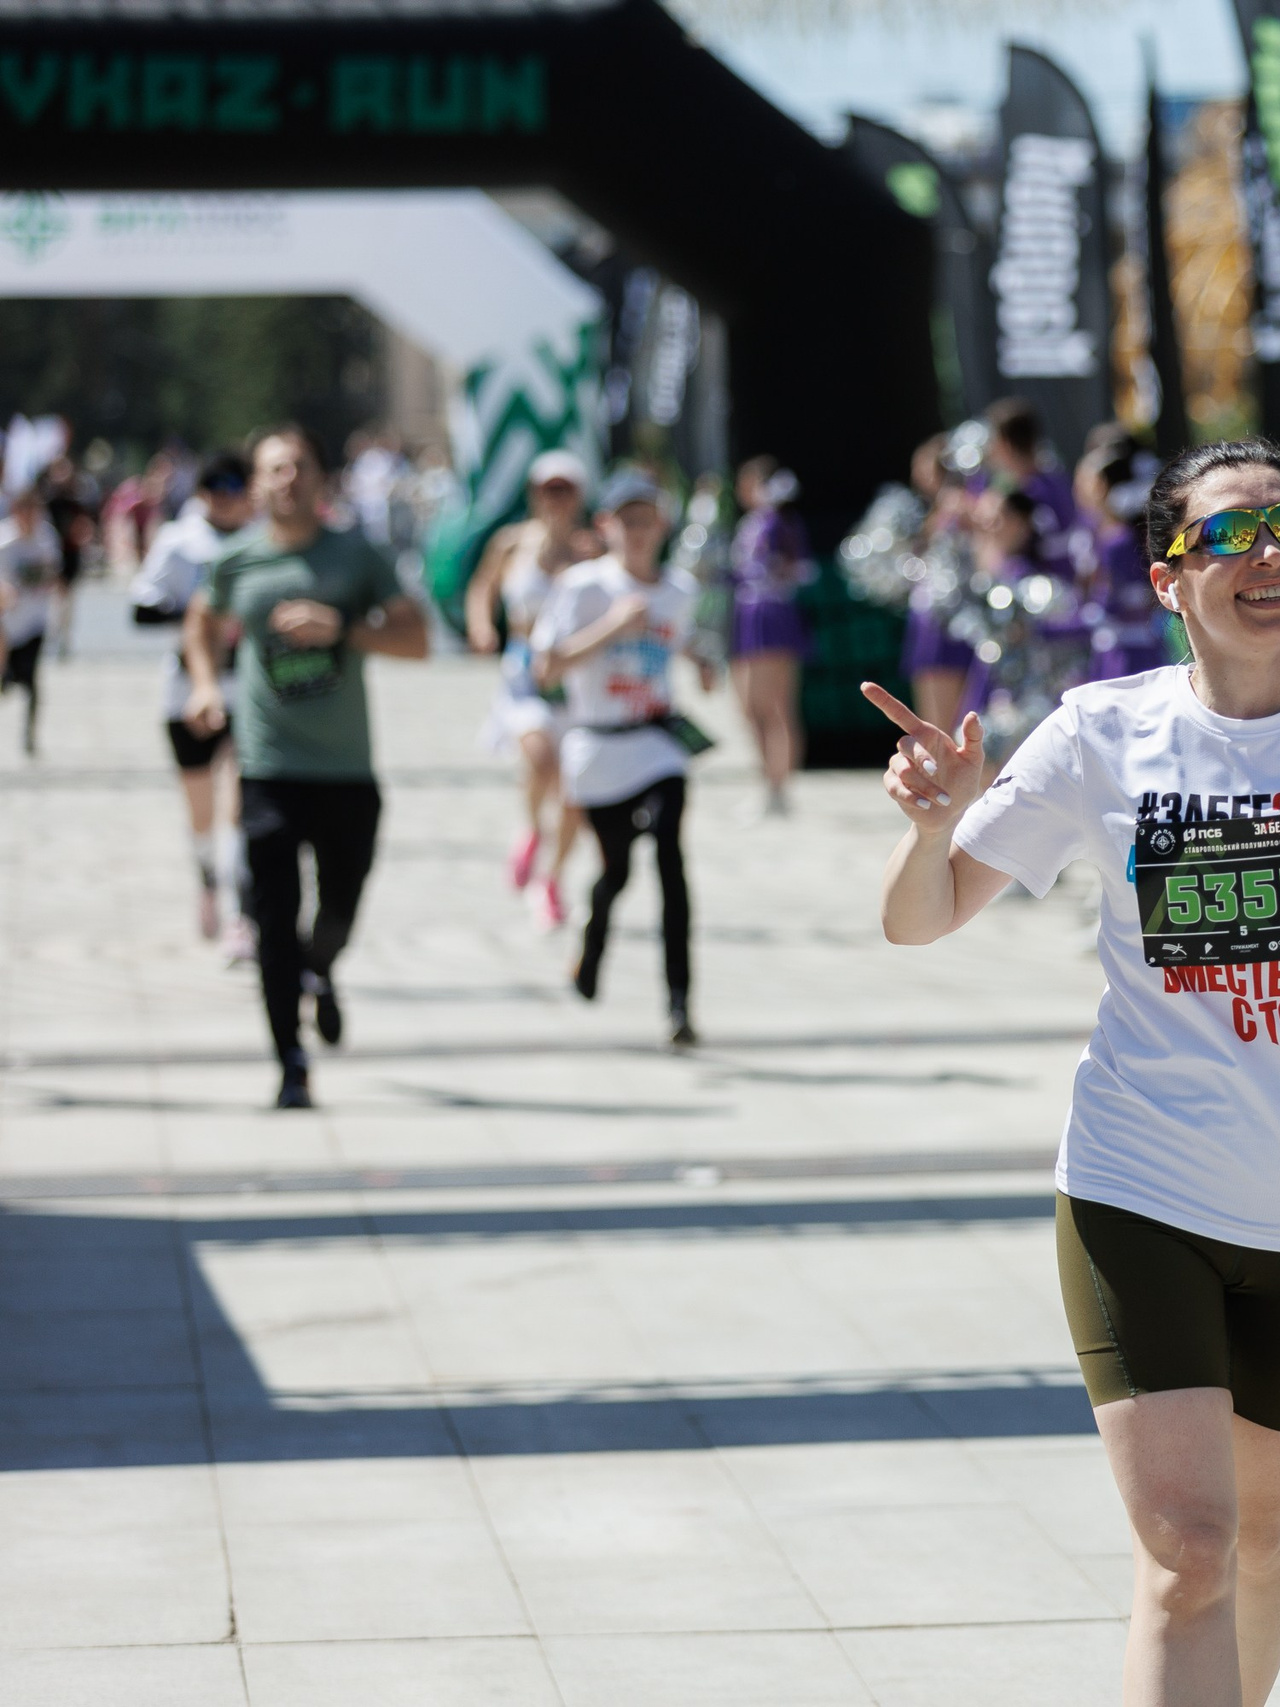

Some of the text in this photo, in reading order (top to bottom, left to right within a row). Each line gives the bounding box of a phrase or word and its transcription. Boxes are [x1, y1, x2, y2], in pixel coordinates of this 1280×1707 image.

[1198, 828, 1223, 839] ПСБ
[1184, 842, 1240, 854] СТАВРОПОЛЬСКИЙ
[1240, 926, 1248, 936] 5
[1232, 997, 1258, 1043] С
